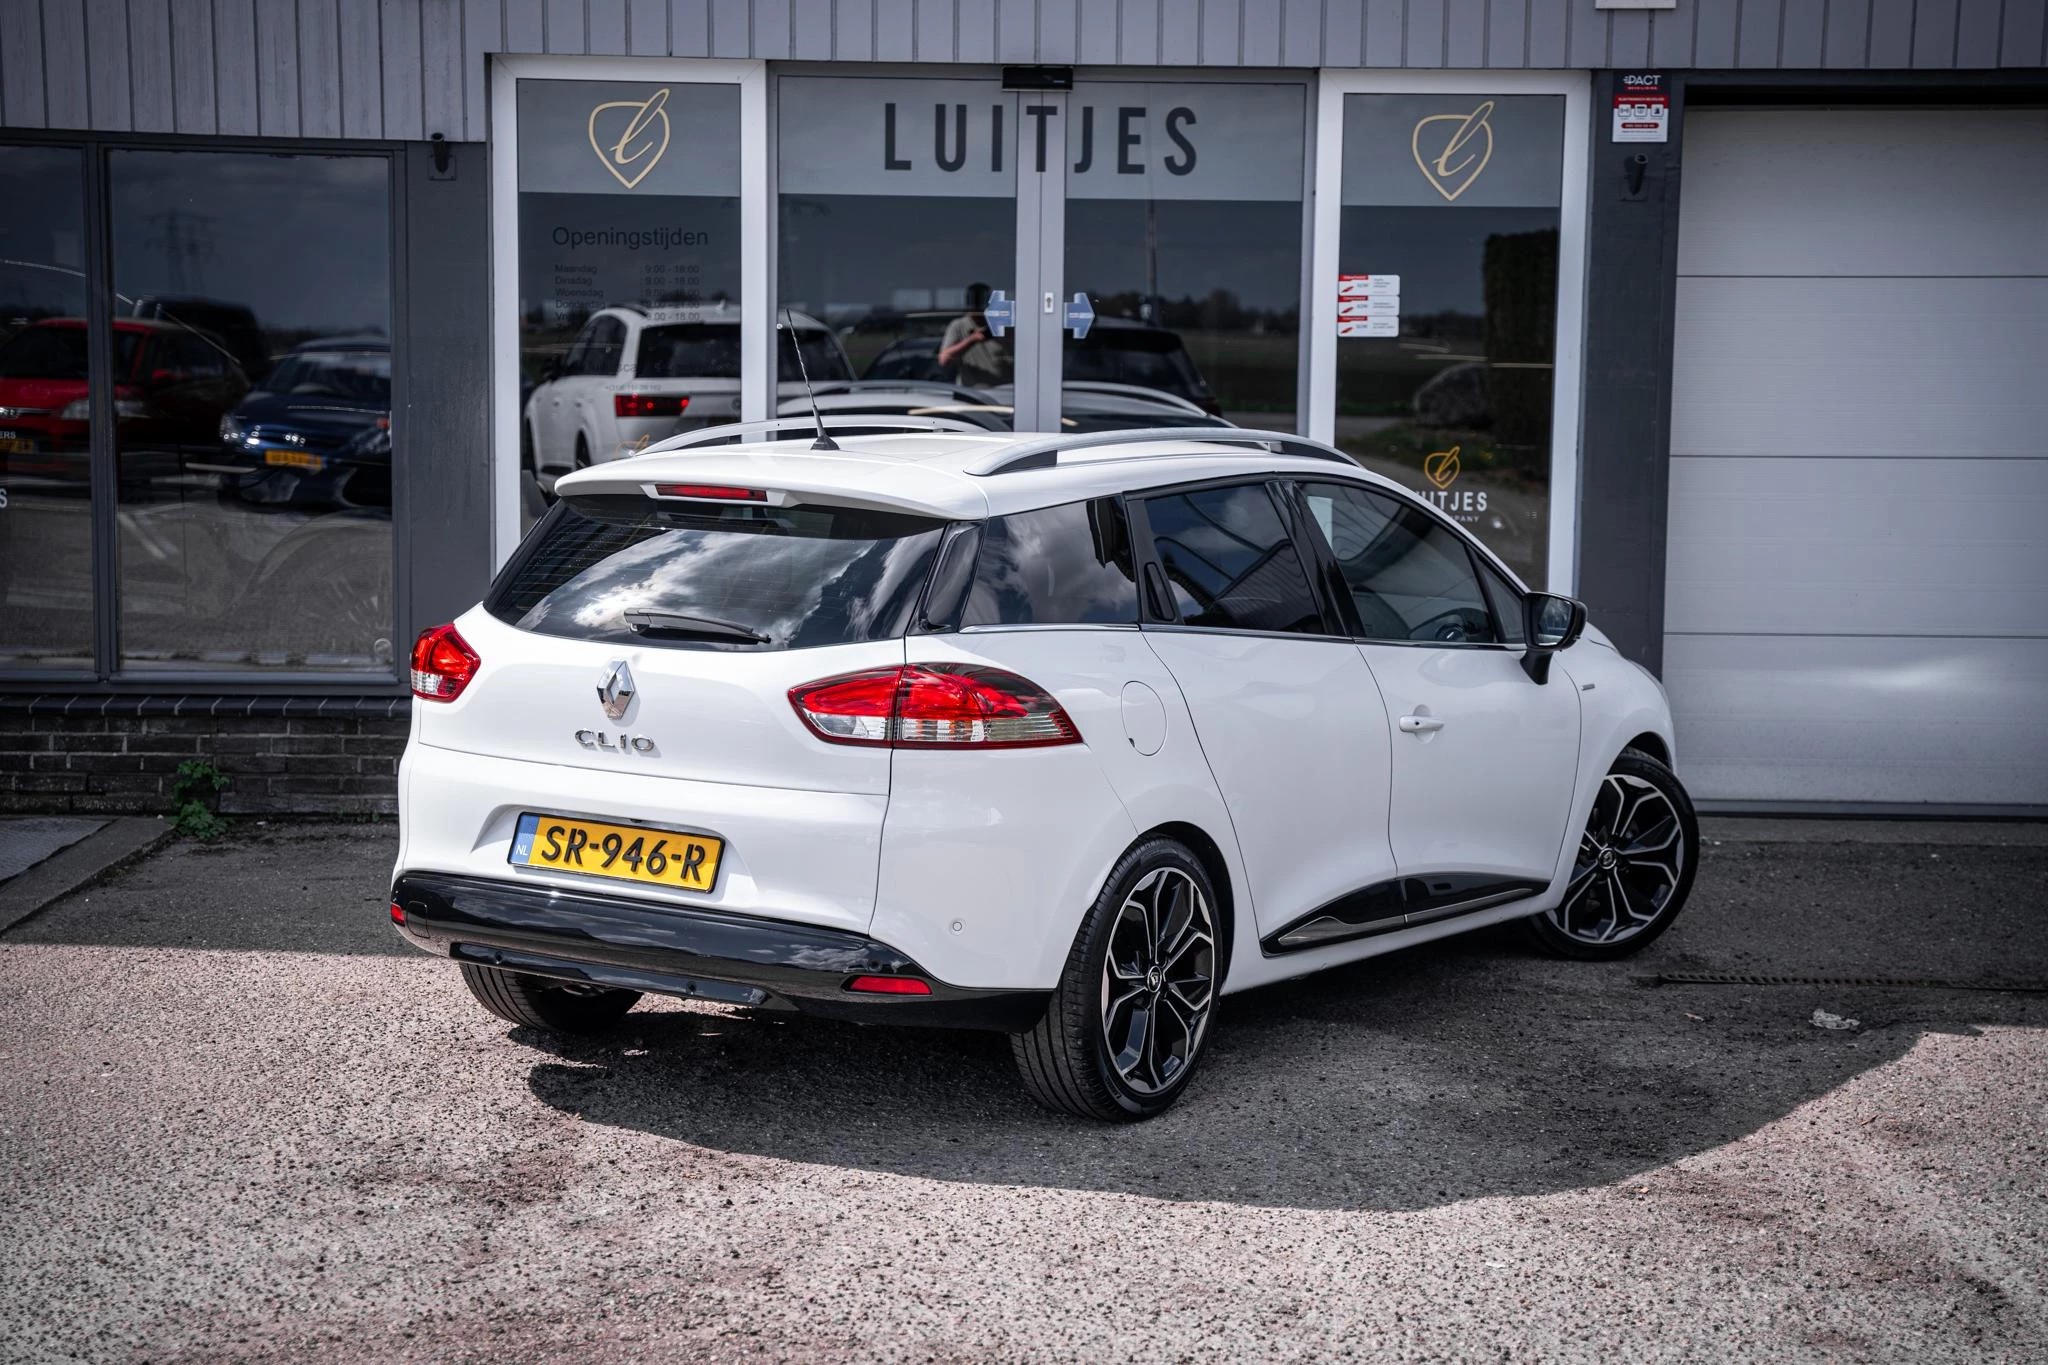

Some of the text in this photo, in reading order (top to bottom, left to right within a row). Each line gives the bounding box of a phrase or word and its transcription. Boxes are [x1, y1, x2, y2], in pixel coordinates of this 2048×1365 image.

[1624, 75, 1661, 85] PACT
[884, 102, 1197, 176] LUITJES
[552, 226, 709, 250] Openingstijden
[554, 264, 598, 274] Maandag
[554, 276, 593, 286] Dinsdag
[574, 728, 655, 752] CLIO
[515, 825, 706, 882] NL SR-946-R
